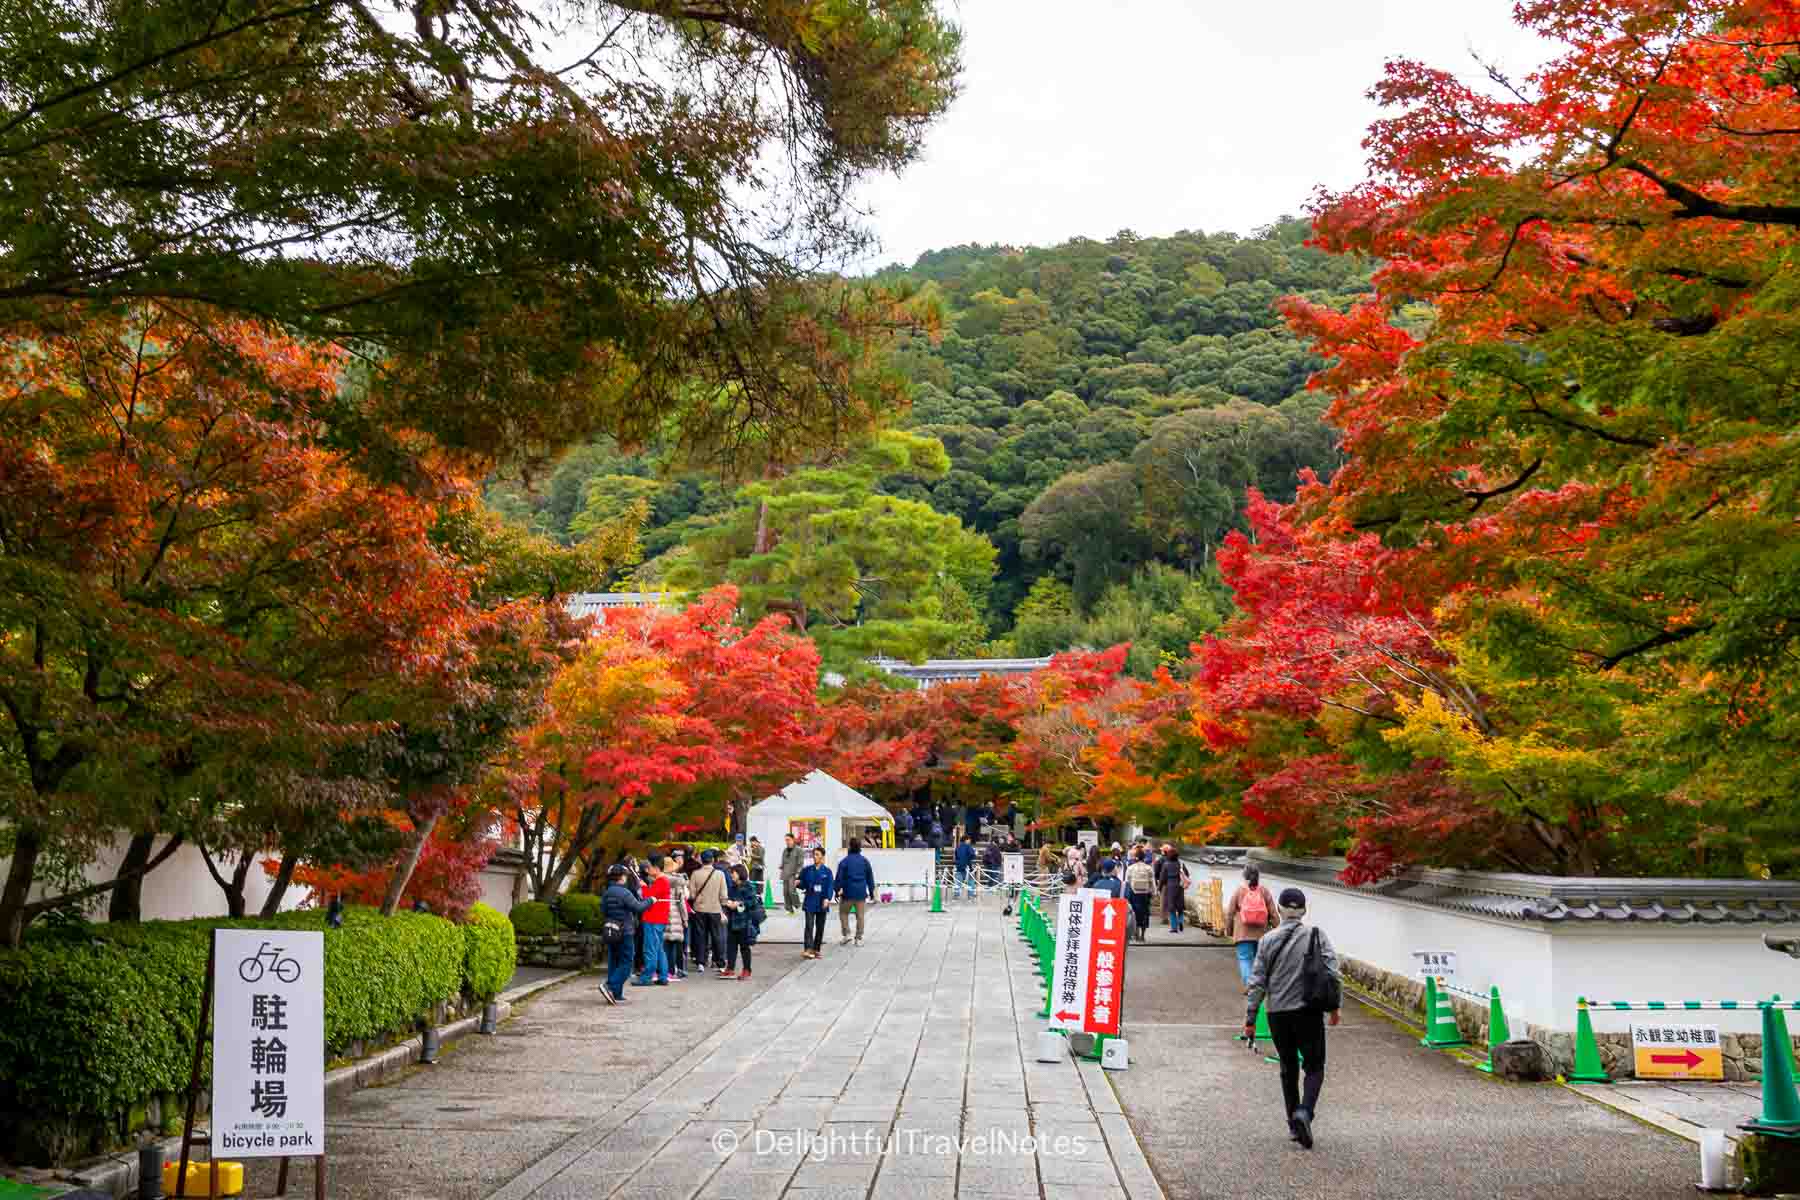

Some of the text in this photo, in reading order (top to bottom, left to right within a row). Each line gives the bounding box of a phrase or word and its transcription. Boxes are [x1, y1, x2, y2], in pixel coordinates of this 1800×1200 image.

[1061, 899, 1083, 1005] 団体参拝者招待券
[1092, 938, 1117, 1025] 一般参拝者
[250, 993, 288, 1119] 駐輪場
[222, 1132, 313, 1149] bicycle park
